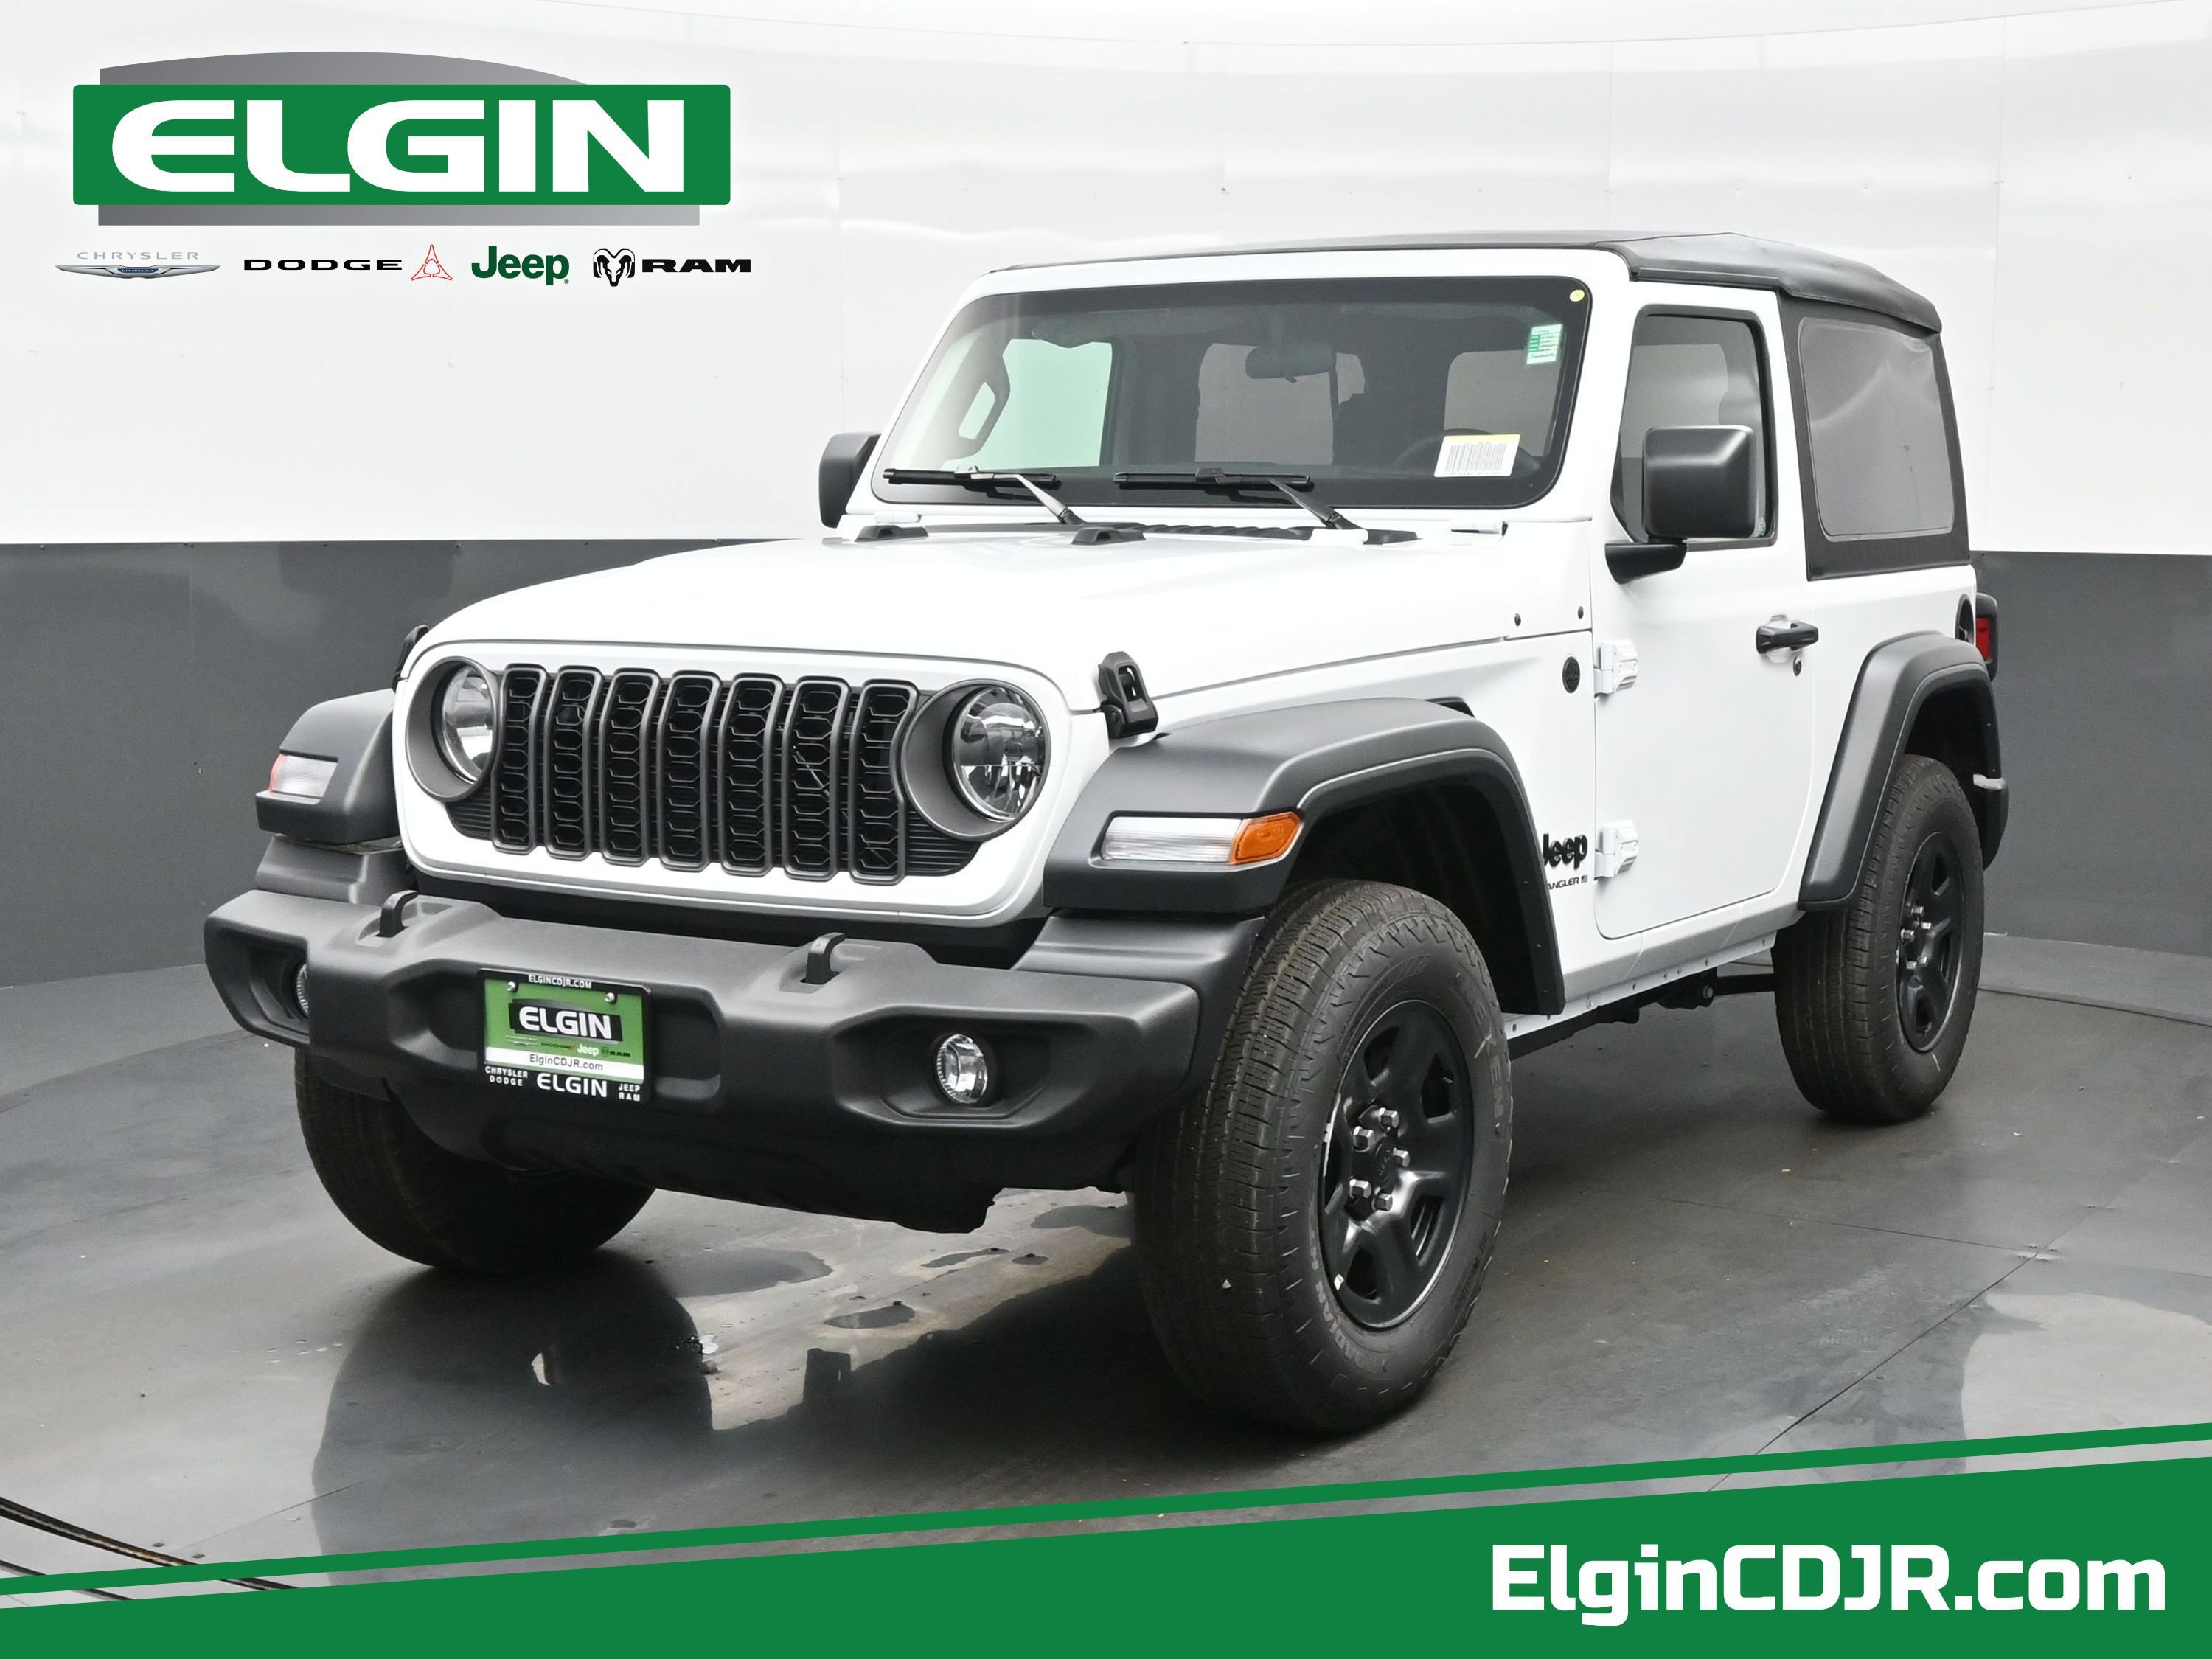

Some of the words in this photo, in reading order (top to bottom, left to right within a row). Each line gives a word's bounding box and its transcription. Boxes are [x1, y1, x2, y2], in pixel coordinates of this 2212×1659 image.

[1542, 833, 1588, 871] Jeep
[1548, 876, 1579, 890] ANGLER
[528, 974, 593, 990] ELGINCDJR.COM
[518, 1006, 613, 1040] ELGIN
[577, 1043, 599, 1057] Jeep
[529, 1053, 604, 1071] ElginCDJR.com
[484, 1065, 529, 1079] CHRYSLER
[489, 1075, 524, 1087] DODGE
[536, 1072, 608, 1099] ELGIN
[618, 1082, 641, 1093] JEEP
[618, 1091, 641, 1102] RAM
